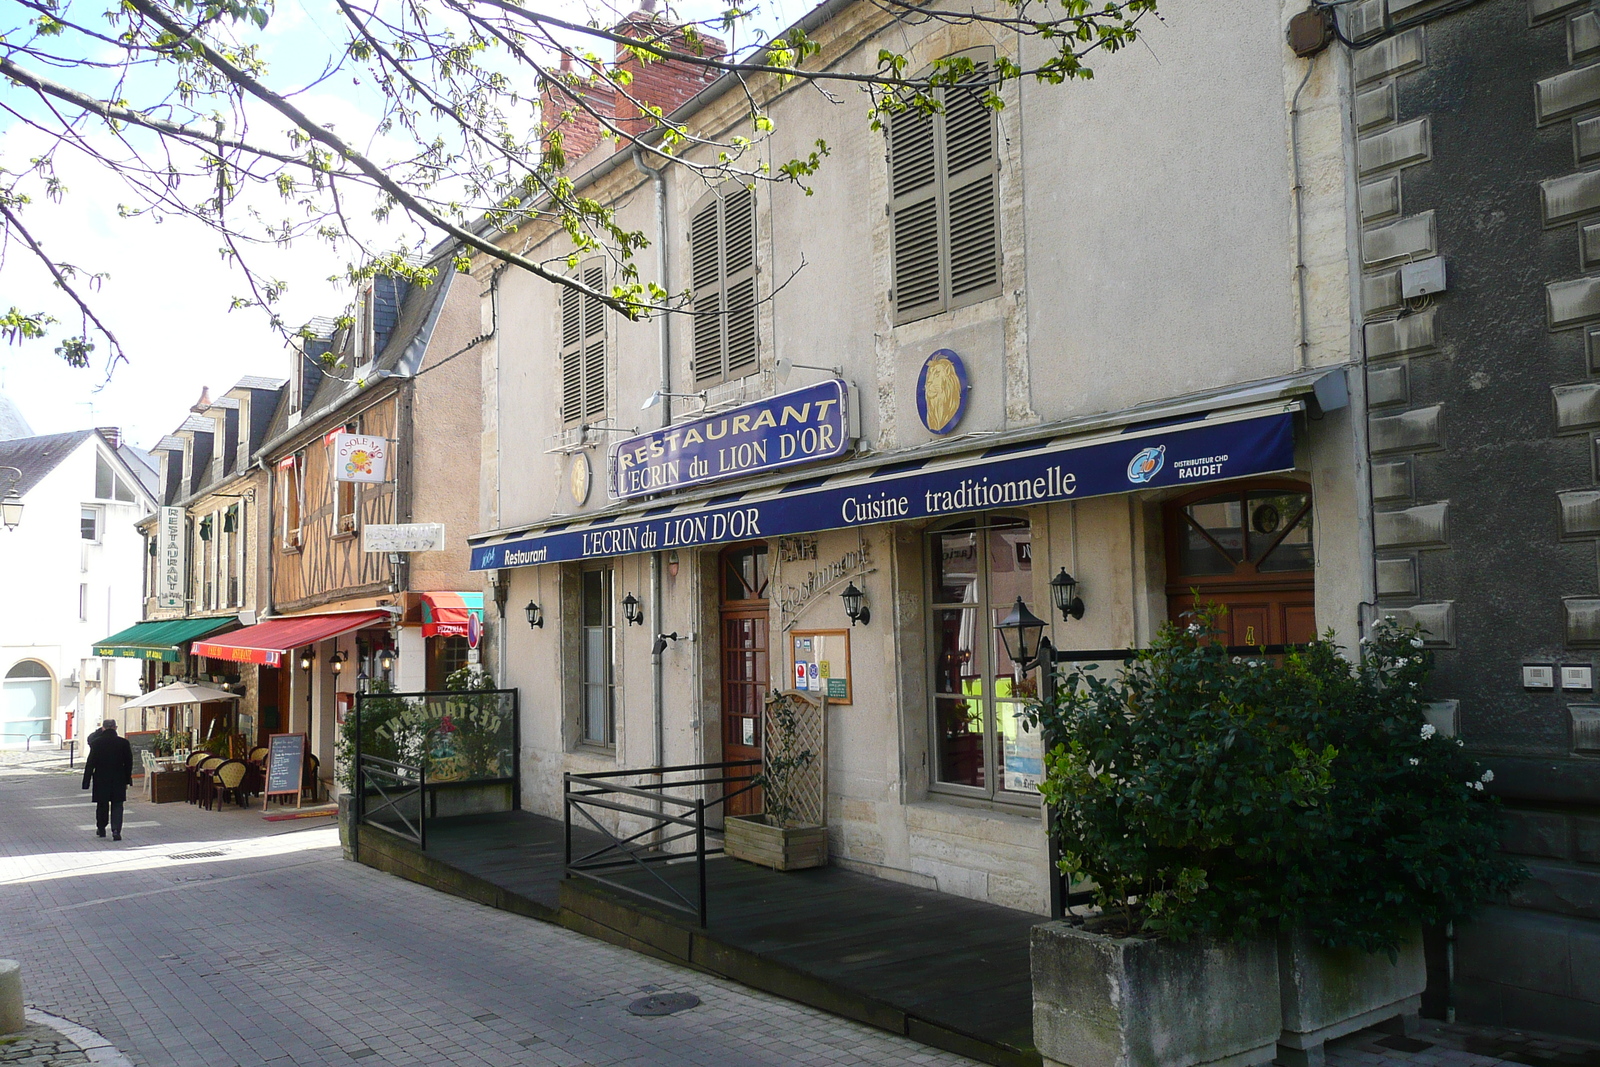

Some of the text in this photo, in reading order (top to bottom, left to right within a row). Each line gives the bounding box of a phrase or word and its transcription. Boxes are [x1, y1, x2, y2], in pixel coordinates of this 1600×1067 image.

[619, 399, 837, 470] RESTAURANT
[345, 437, 368, 449] SOLE
[369, 441, 384, 459] MIO
[620, 424, 835, 493] L'ECRIN du LION D'OR
[1174, 454, 1229, 468] DISTRIBUTEUR CHD
[1179, 463, 1223, 479] RAUDET
[842, 465, 1077, 522] Cuisine traditionnelle
[582, 507, 761, 556] L'ECRIN du LION D'OR
[167, 508, 179, 591] RESTAURANT
[504, 545, 547, 566] Restaurant
[437, 625, 464, 634] PIZZERIA
[1246, 626, 1255, 646] 4
